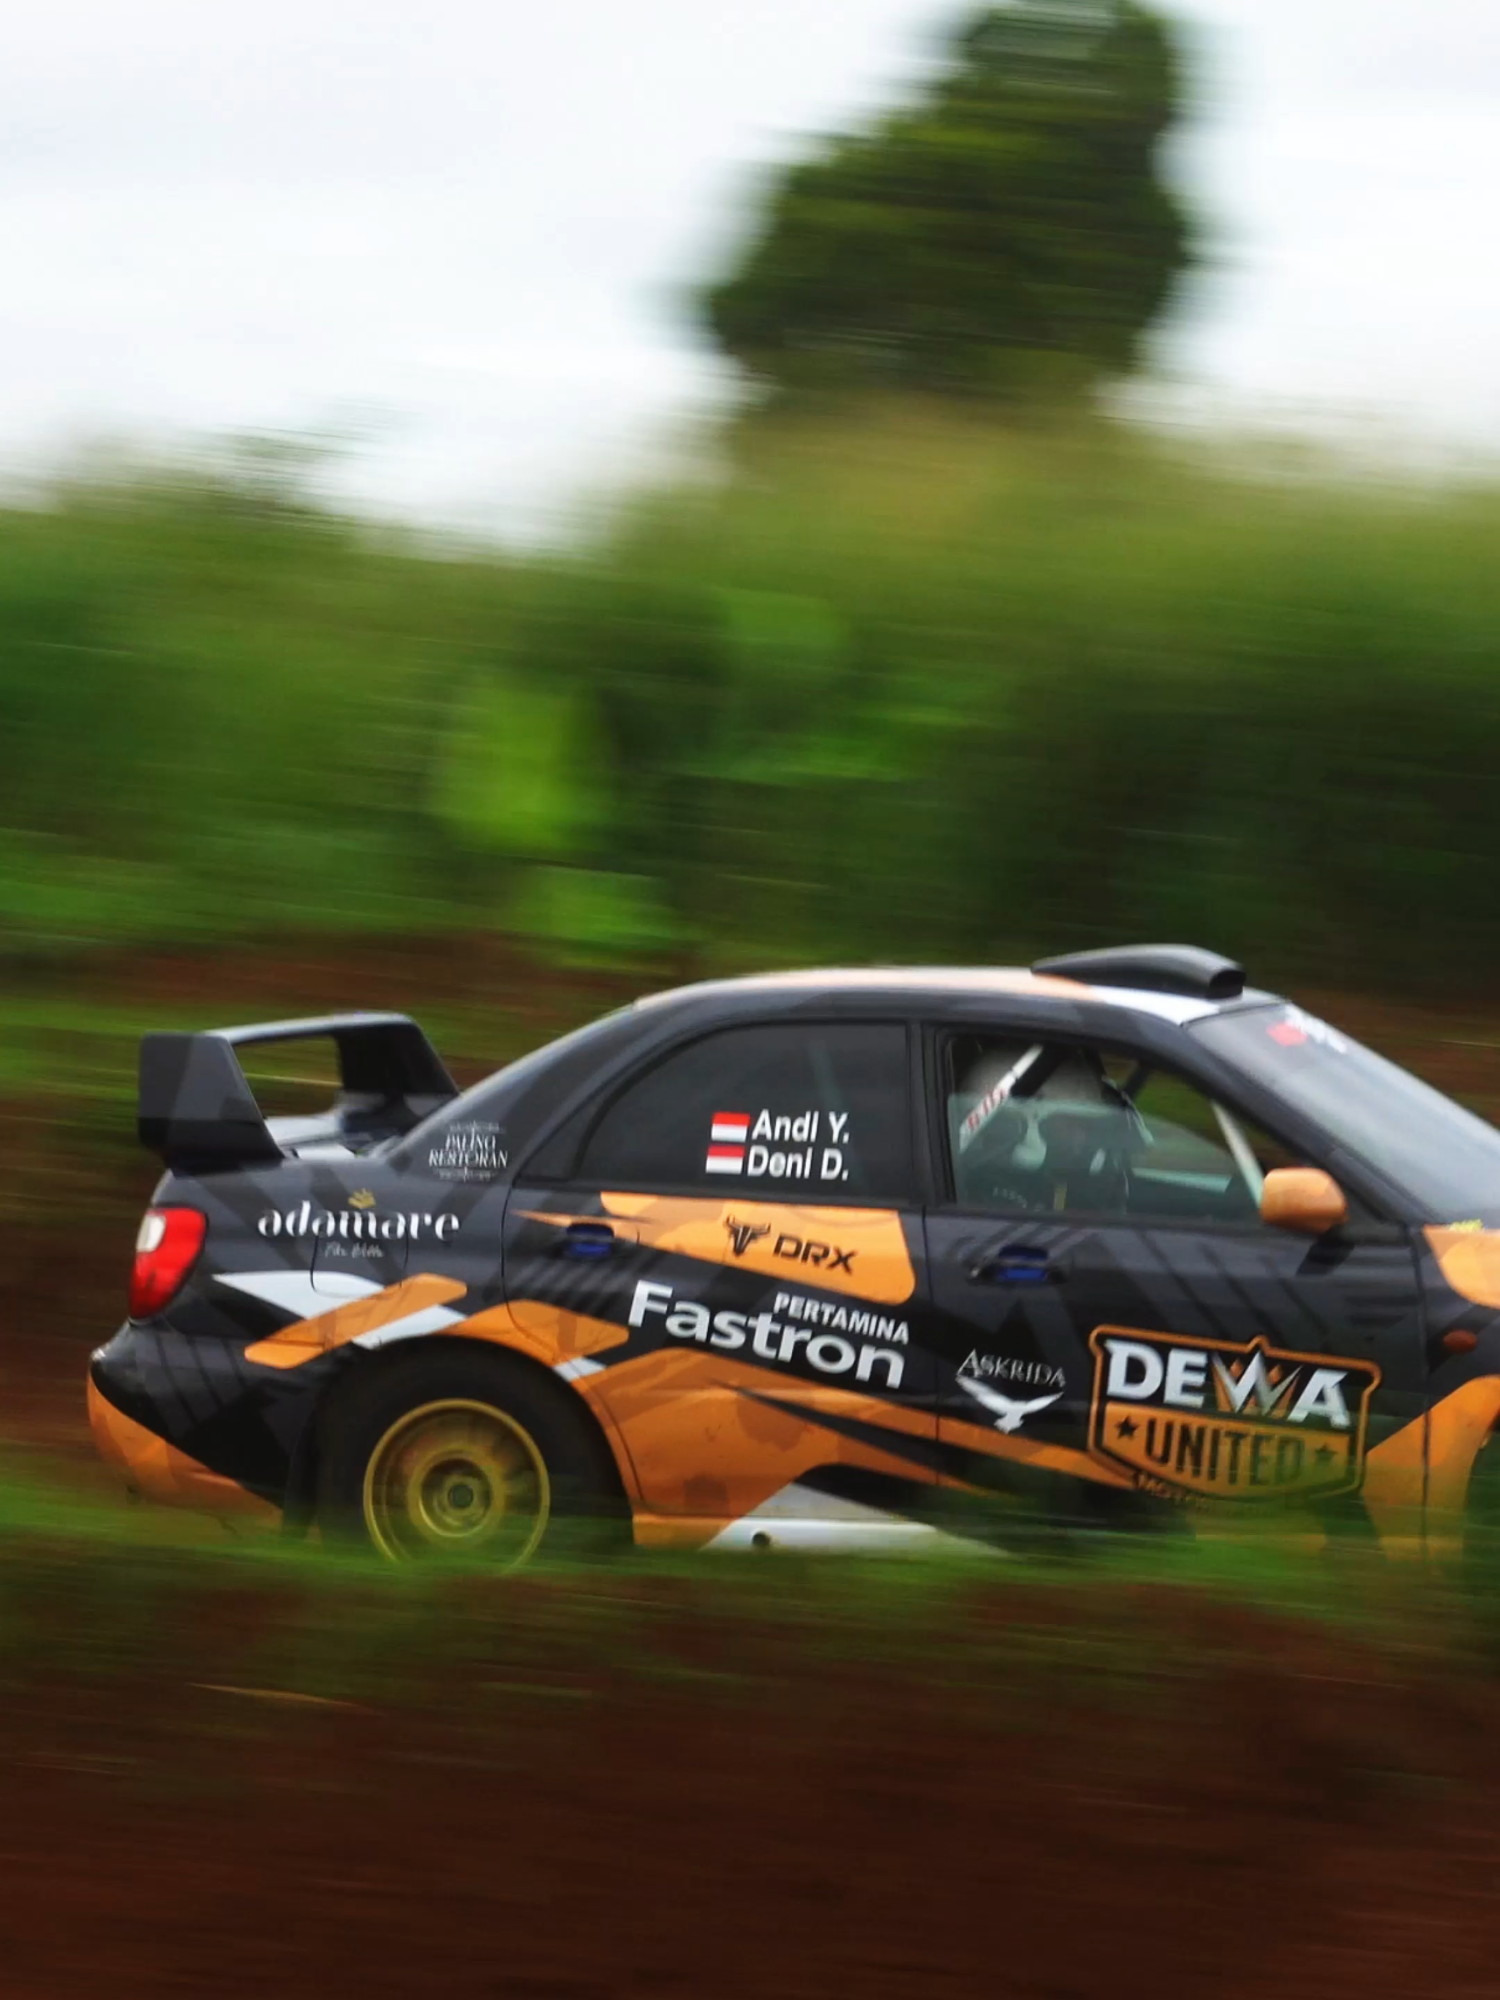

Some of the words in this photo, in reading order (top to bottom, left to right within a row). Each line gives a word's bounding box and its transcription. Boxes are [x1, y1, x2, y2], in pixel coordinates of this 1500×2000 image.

[829, 1111, 849, 1143] Y.
[821, 1148, 849, 1181] D.
[258, 1200, 460, 1240] adamare
[772, 1234, 858, 1274] DRX
[628, 1280, 905, 1389] Fastron
[773, 1292, 909, 1344] PERTAMINA
[1104, 1339, 1351, 1428] DEWA
[1145, 1418, 1305, 1486] UNITED
